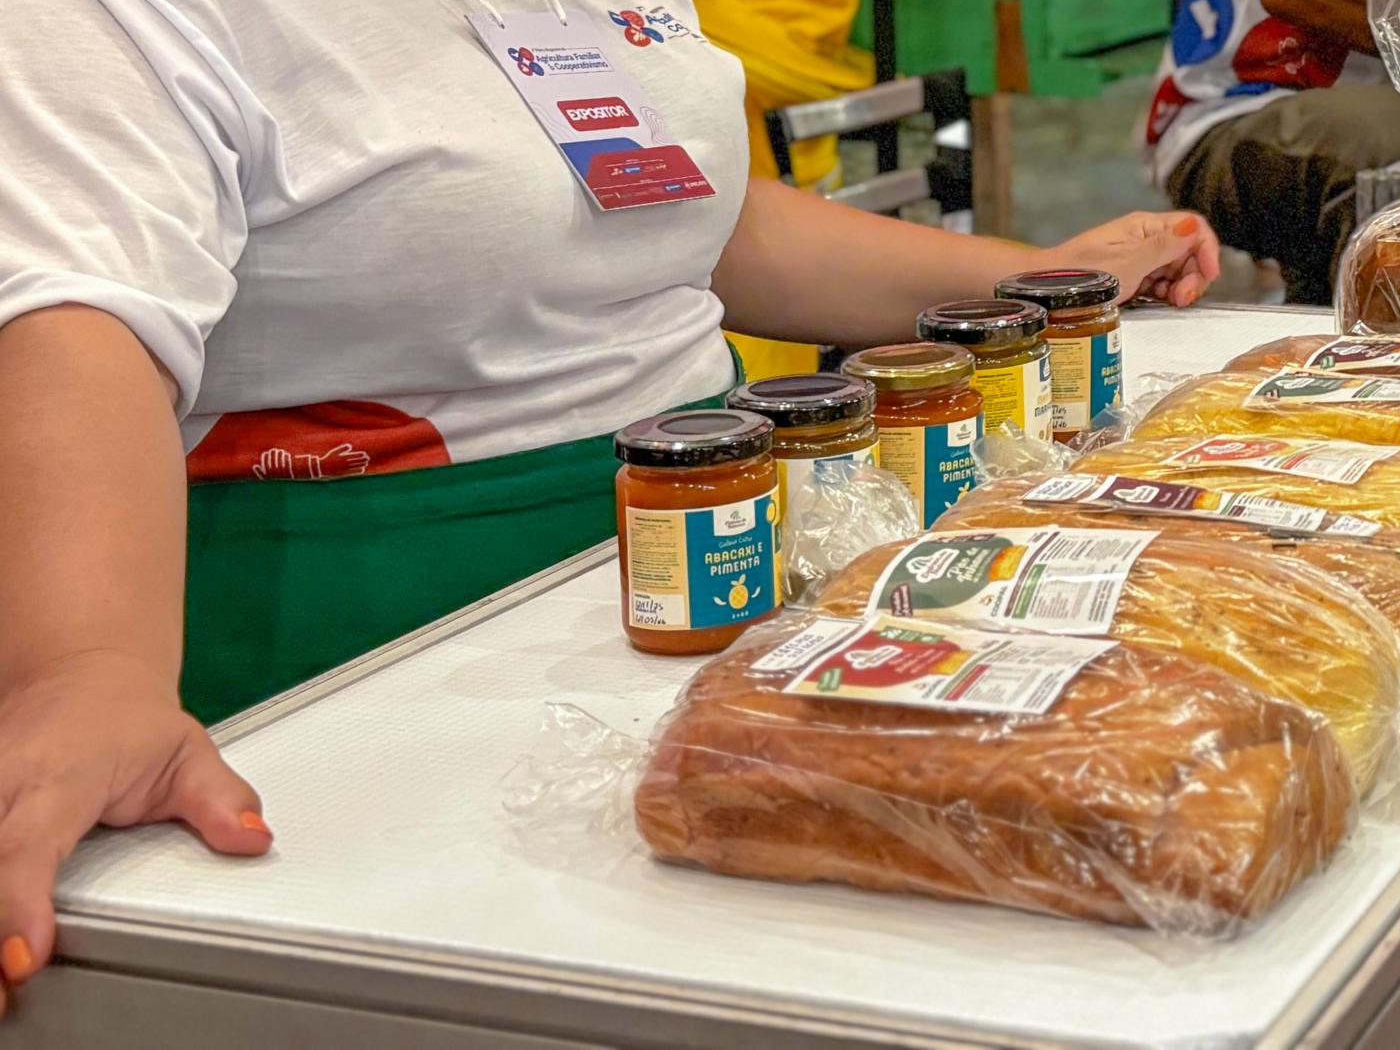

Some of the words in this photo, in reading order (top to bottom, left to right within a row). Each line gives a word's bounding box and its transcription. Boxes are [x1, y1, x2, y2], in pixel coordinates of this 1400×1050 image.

[566, 105, 629, 121] EXPOSITOR
[704, 544, 756, 565] ABACAXI
[758, 541, 764, 553] E
[710, 555, 761, 577] PIMENTA
